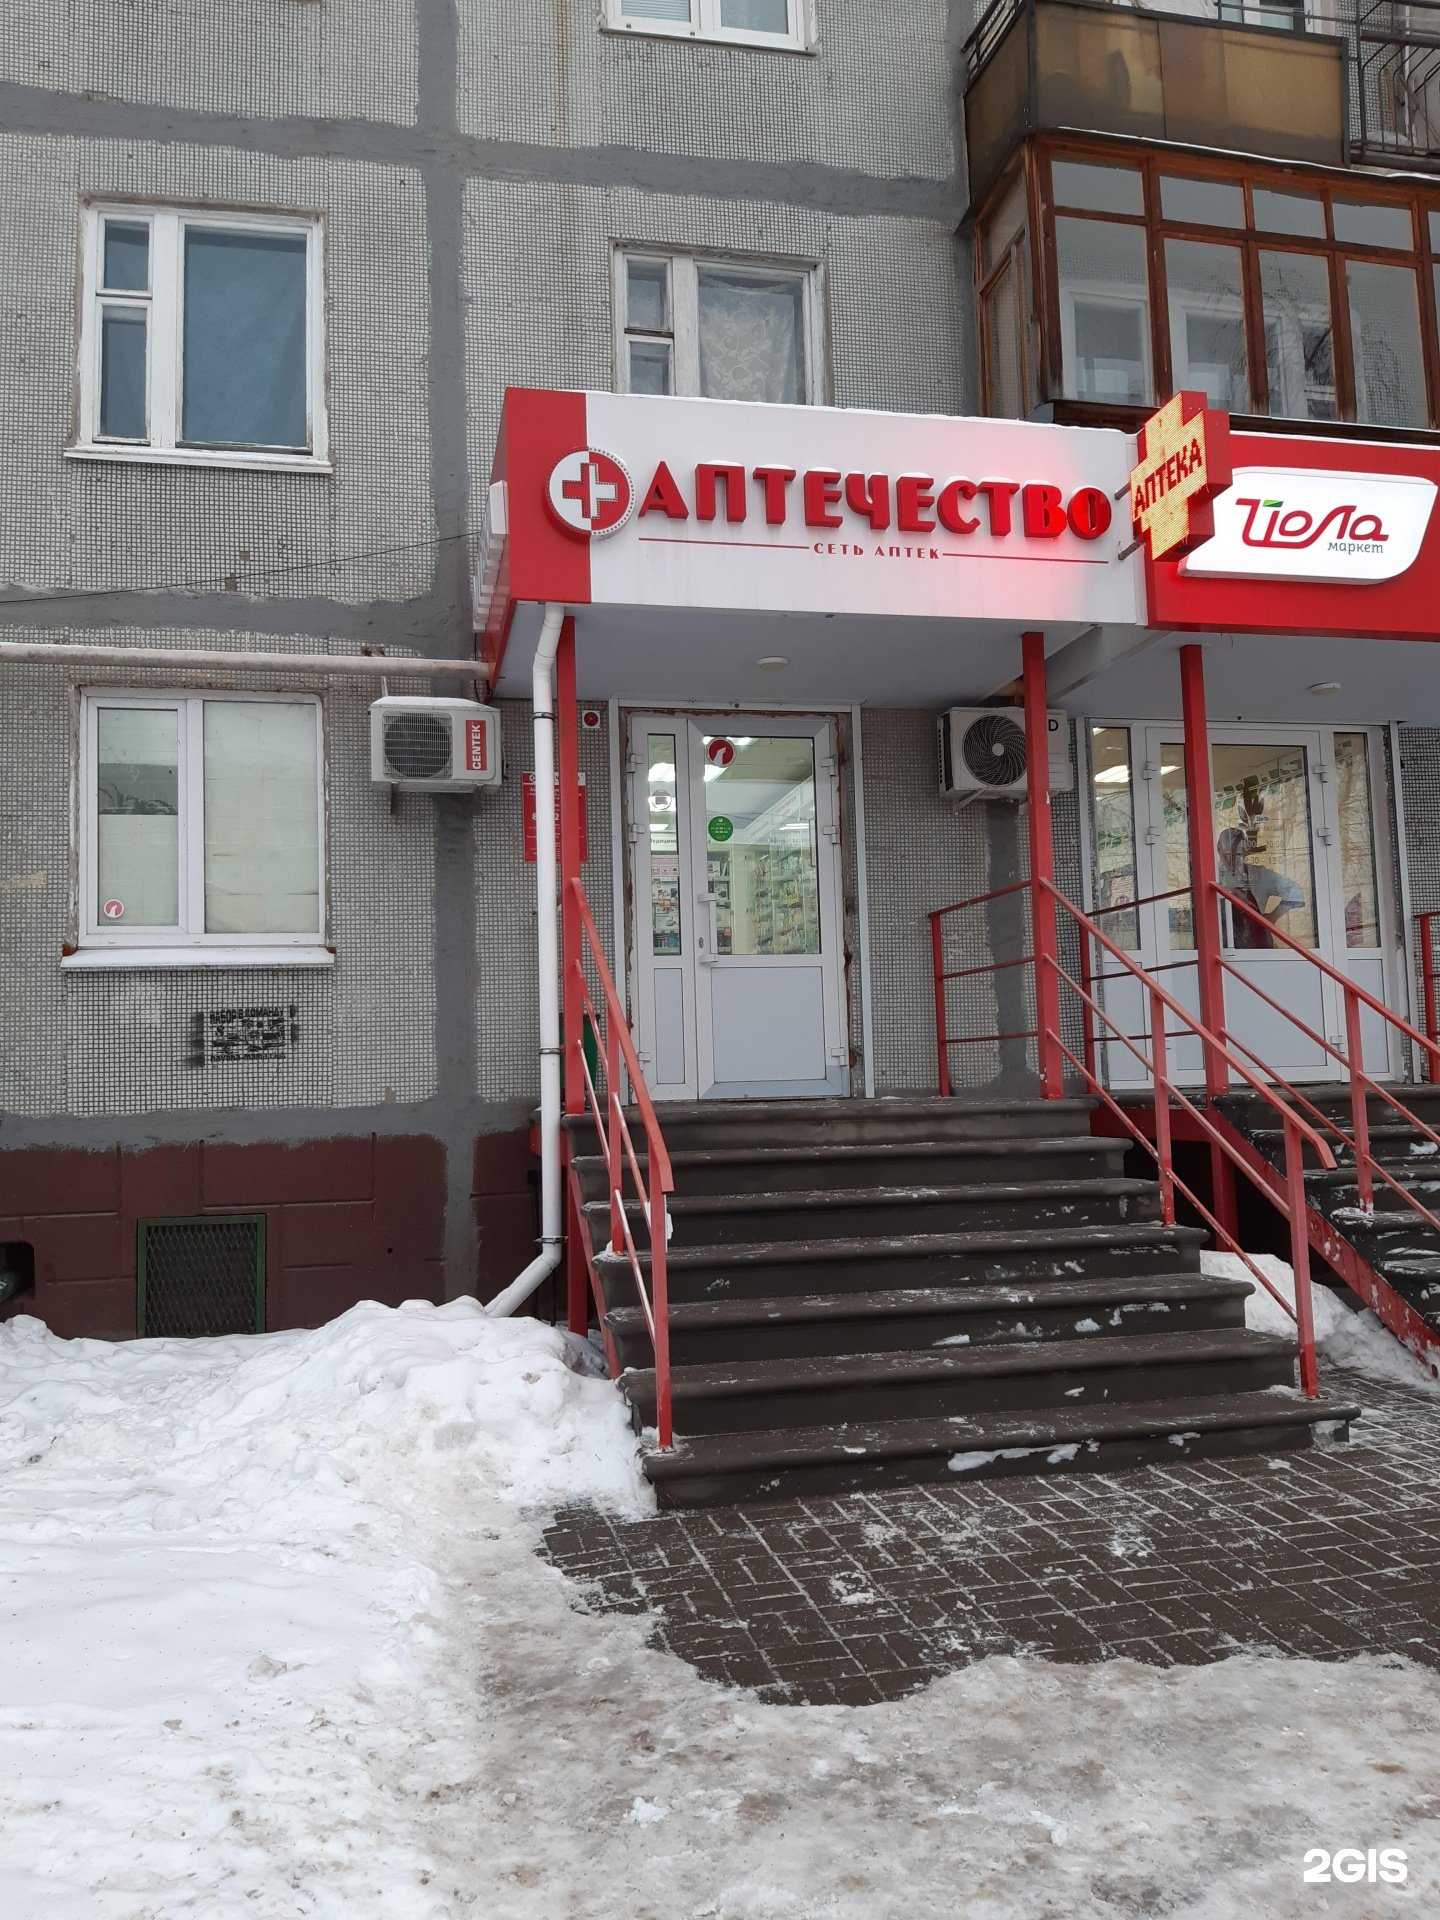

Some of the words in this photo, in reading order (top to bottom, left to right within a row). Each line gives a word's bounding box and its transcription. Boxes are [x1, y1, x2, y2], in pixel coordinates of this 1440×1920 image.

[638, 460, 1112, 541] АПТЕЧЕСТВО
[1133, 437, 1203, 518] АПТЕКА
[813, 542, 864, 556] СЕТЬ
[874, 544, 941, 560] АПТЕК
[1327, 541, 1385, 555] маркет
[471, 724, 482, 770] CENTEK
